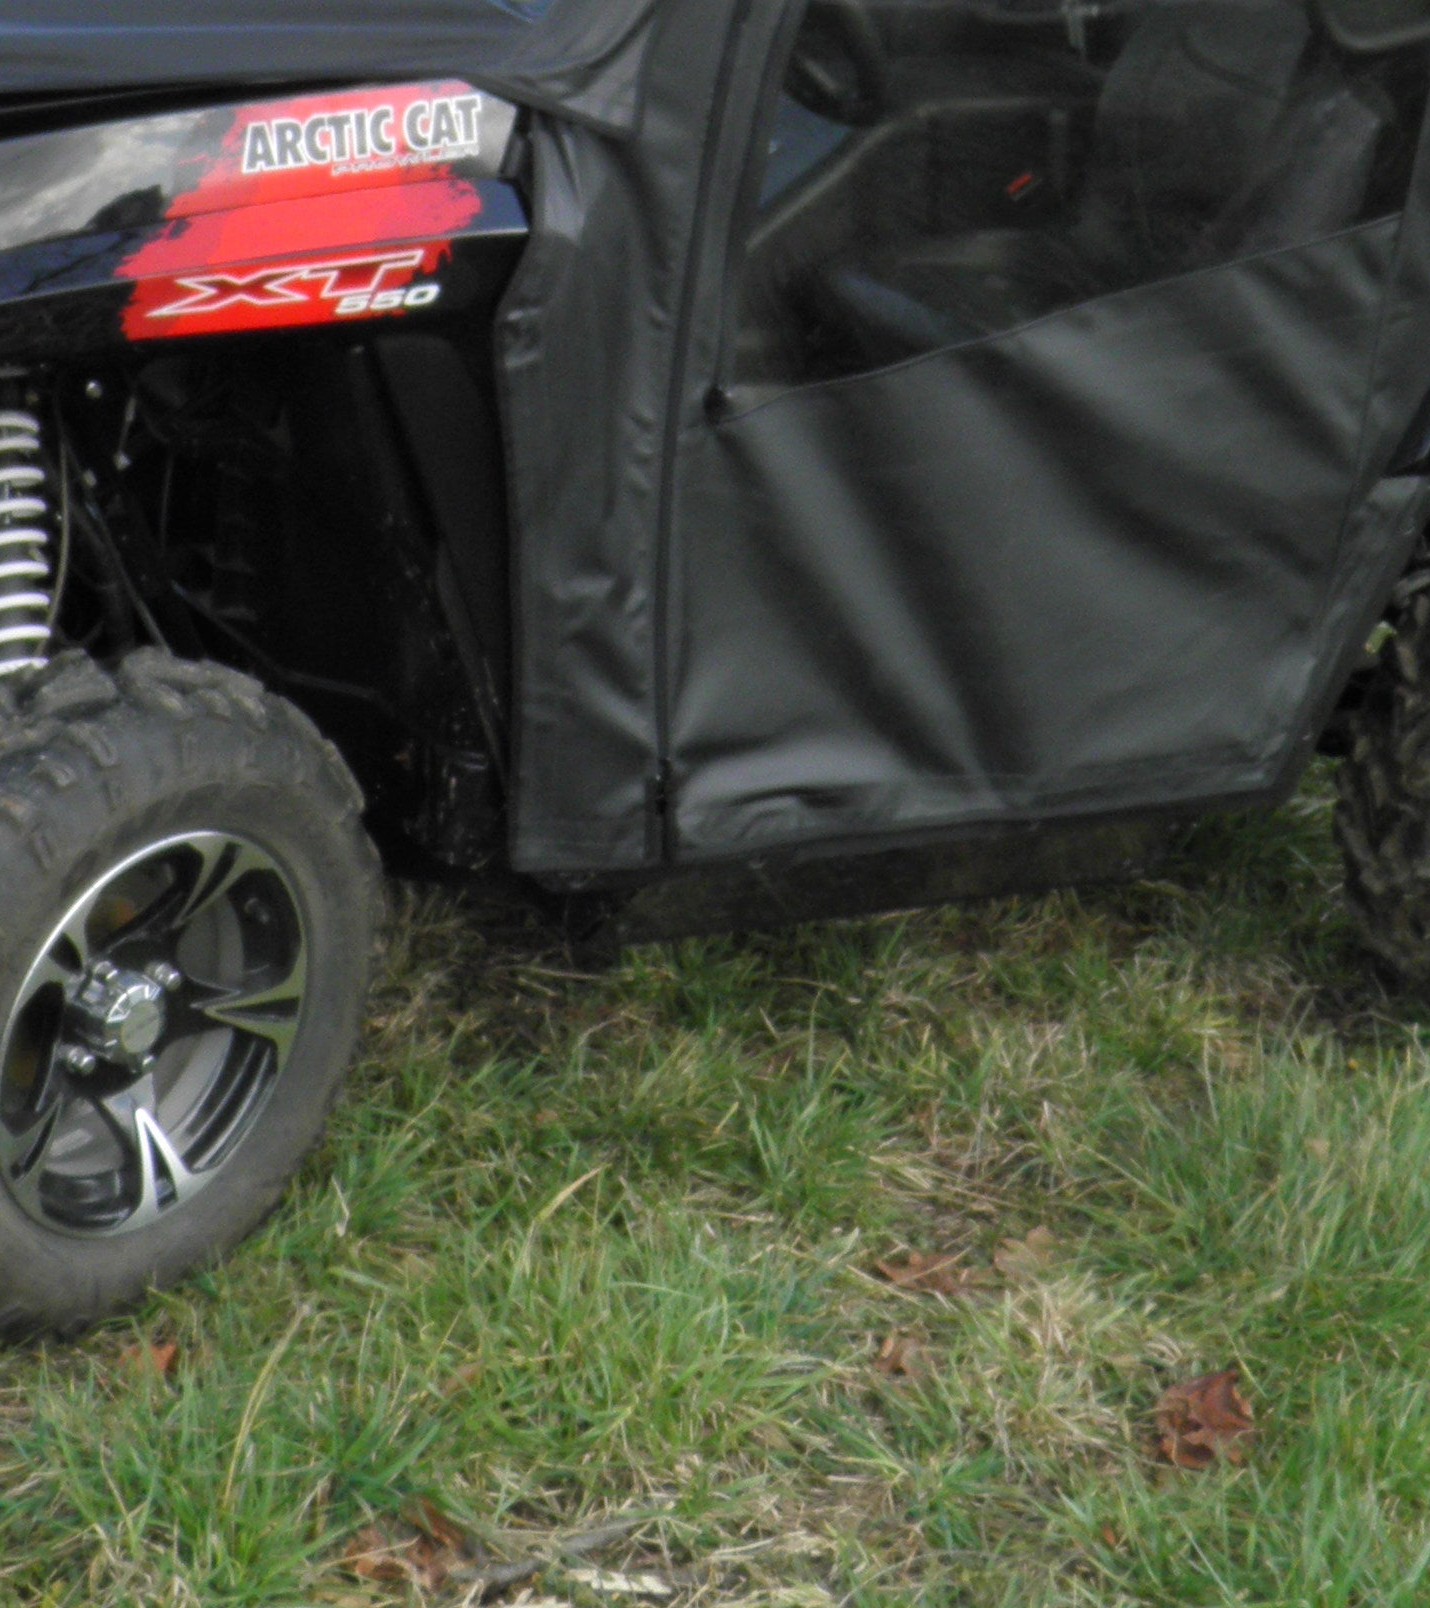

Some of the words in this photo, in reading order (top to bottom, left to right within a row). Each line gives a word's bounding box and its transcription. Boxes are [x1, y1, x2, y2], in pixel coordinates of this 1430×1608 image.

[242, 106, 396, 174] ARCTIC
[403, 95, 482, 151] CAT
[145, 249, 425, 317] XT
[334, 282, 440, 315] 550
